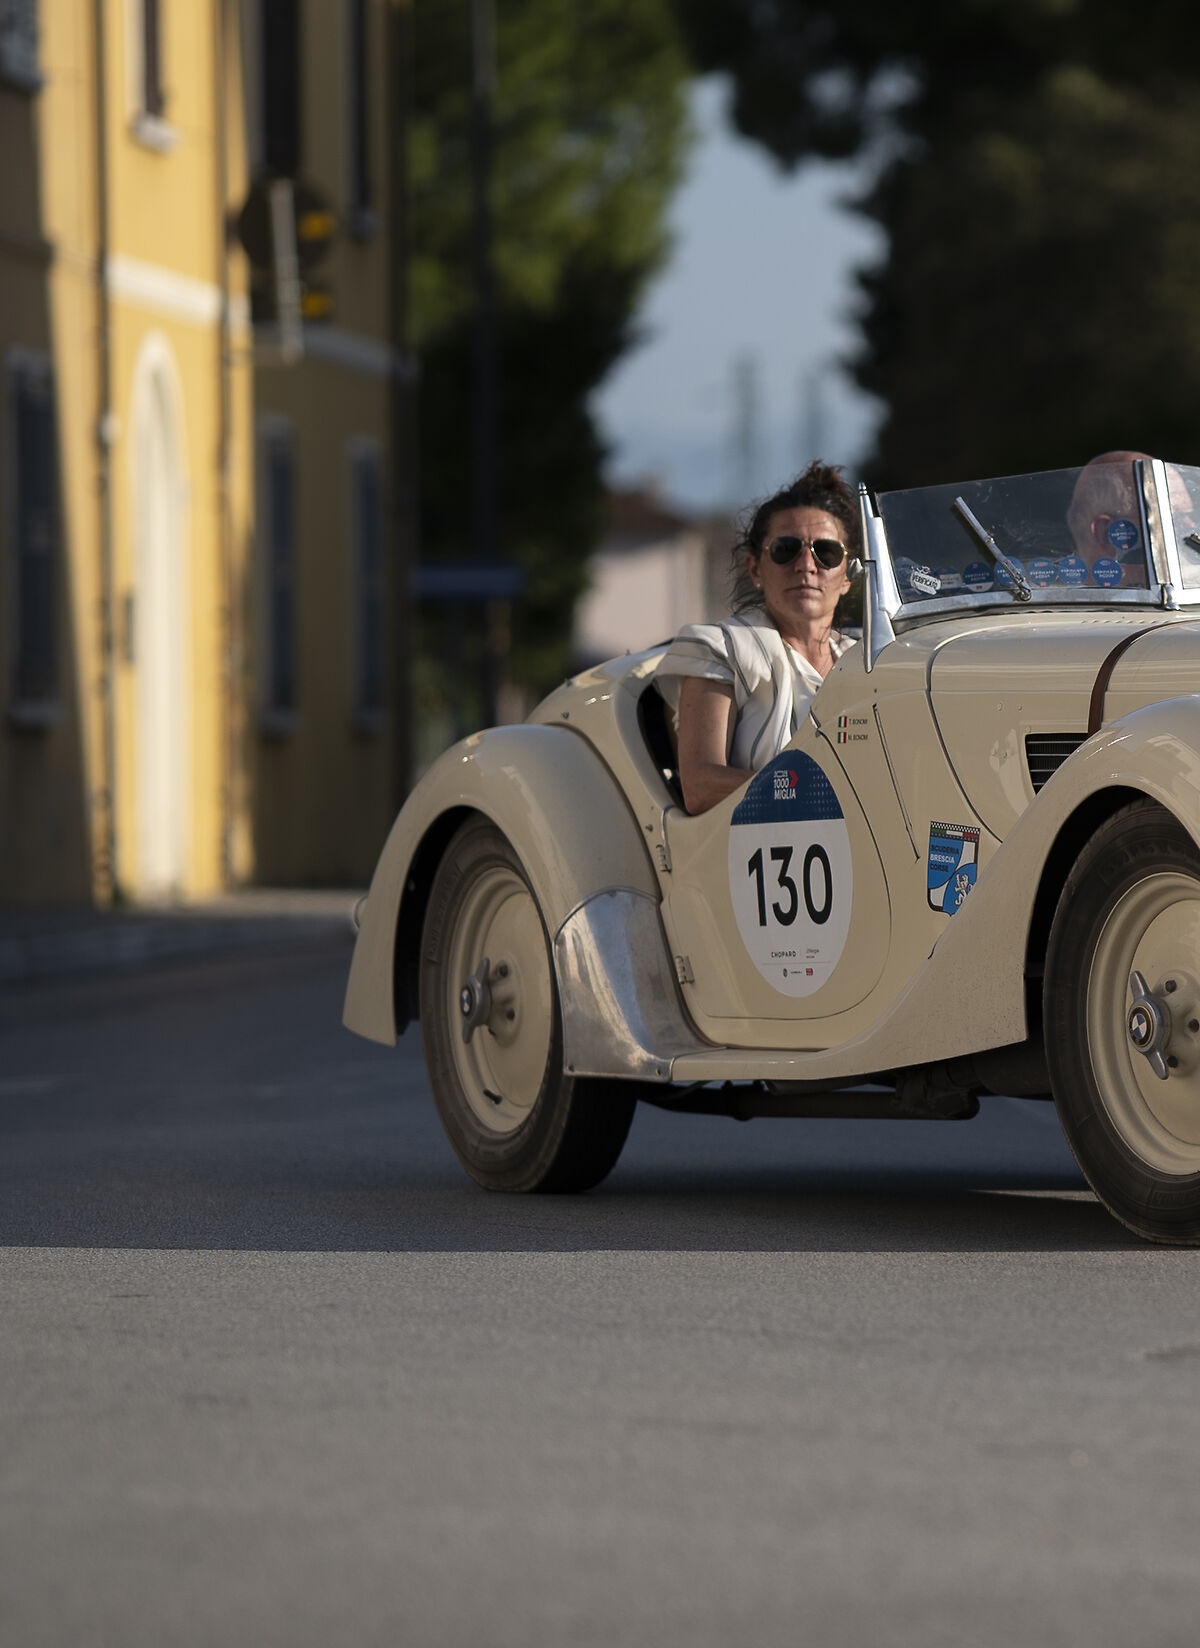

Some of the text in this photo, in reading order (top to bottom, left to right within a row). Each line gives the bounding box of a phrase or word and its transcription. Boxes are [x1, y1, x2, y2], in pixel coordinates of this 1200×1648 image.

[774, 778, 789, 788] 1000
[774, 788, 796, 800] MIGLIA
[930, 853, 955, 864] BRESCIA
[748, 843, 833, 927] 130
